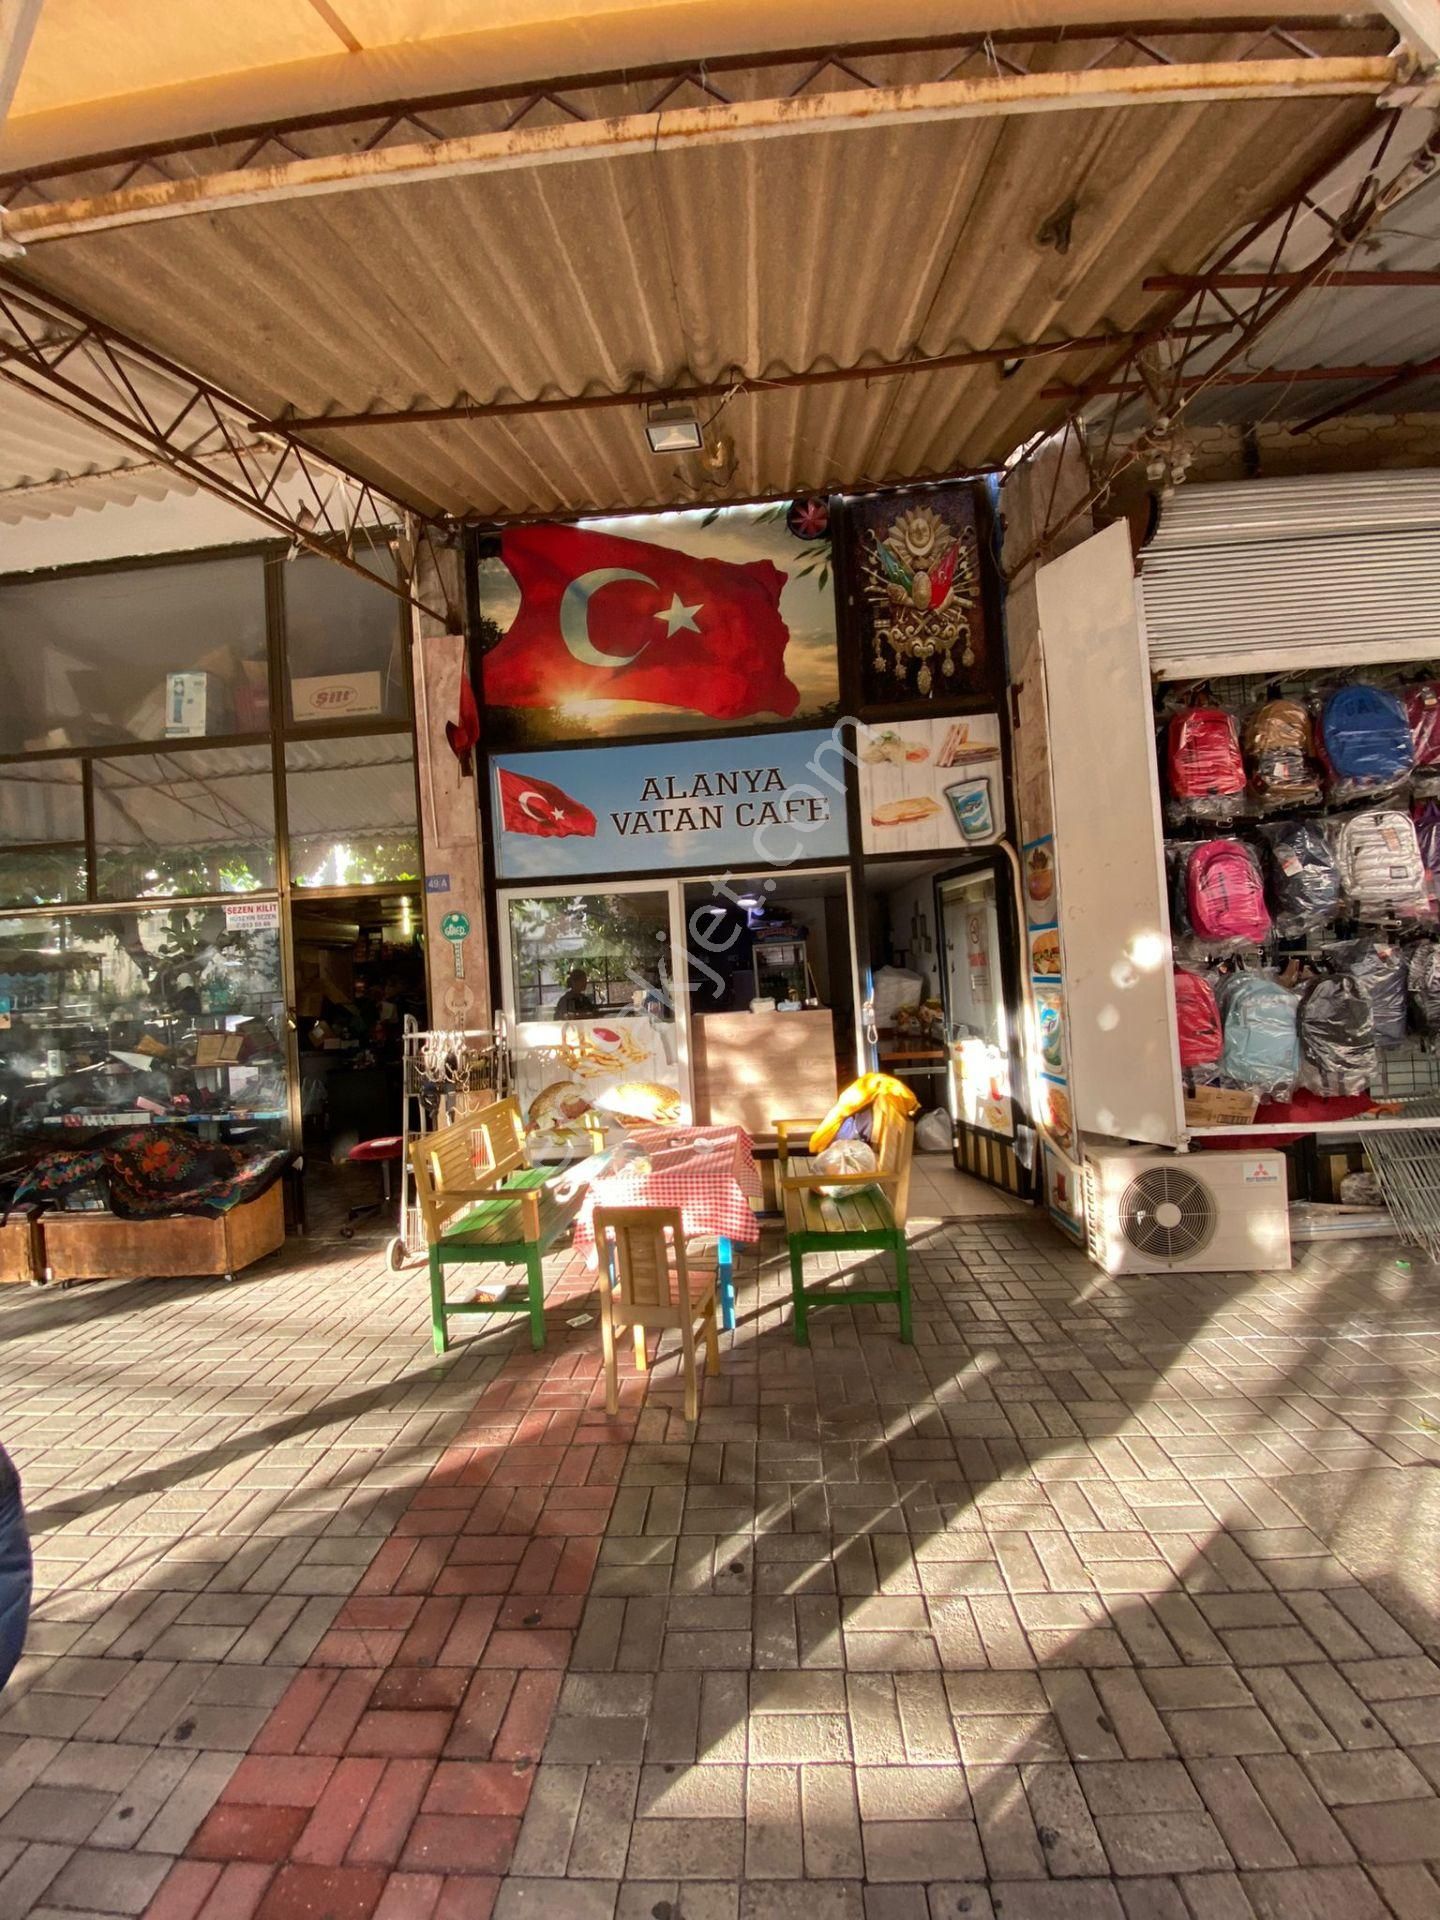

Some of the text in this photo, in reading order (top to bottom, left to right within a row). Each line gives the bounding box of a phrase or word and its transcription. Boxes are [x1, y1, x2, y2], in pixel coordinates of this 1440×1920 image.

[640, 767, 786, 802] ALANYA
[610, 797, 830, 836] VATAN CAFE
[227, 905, 254, 915] SEZEN
